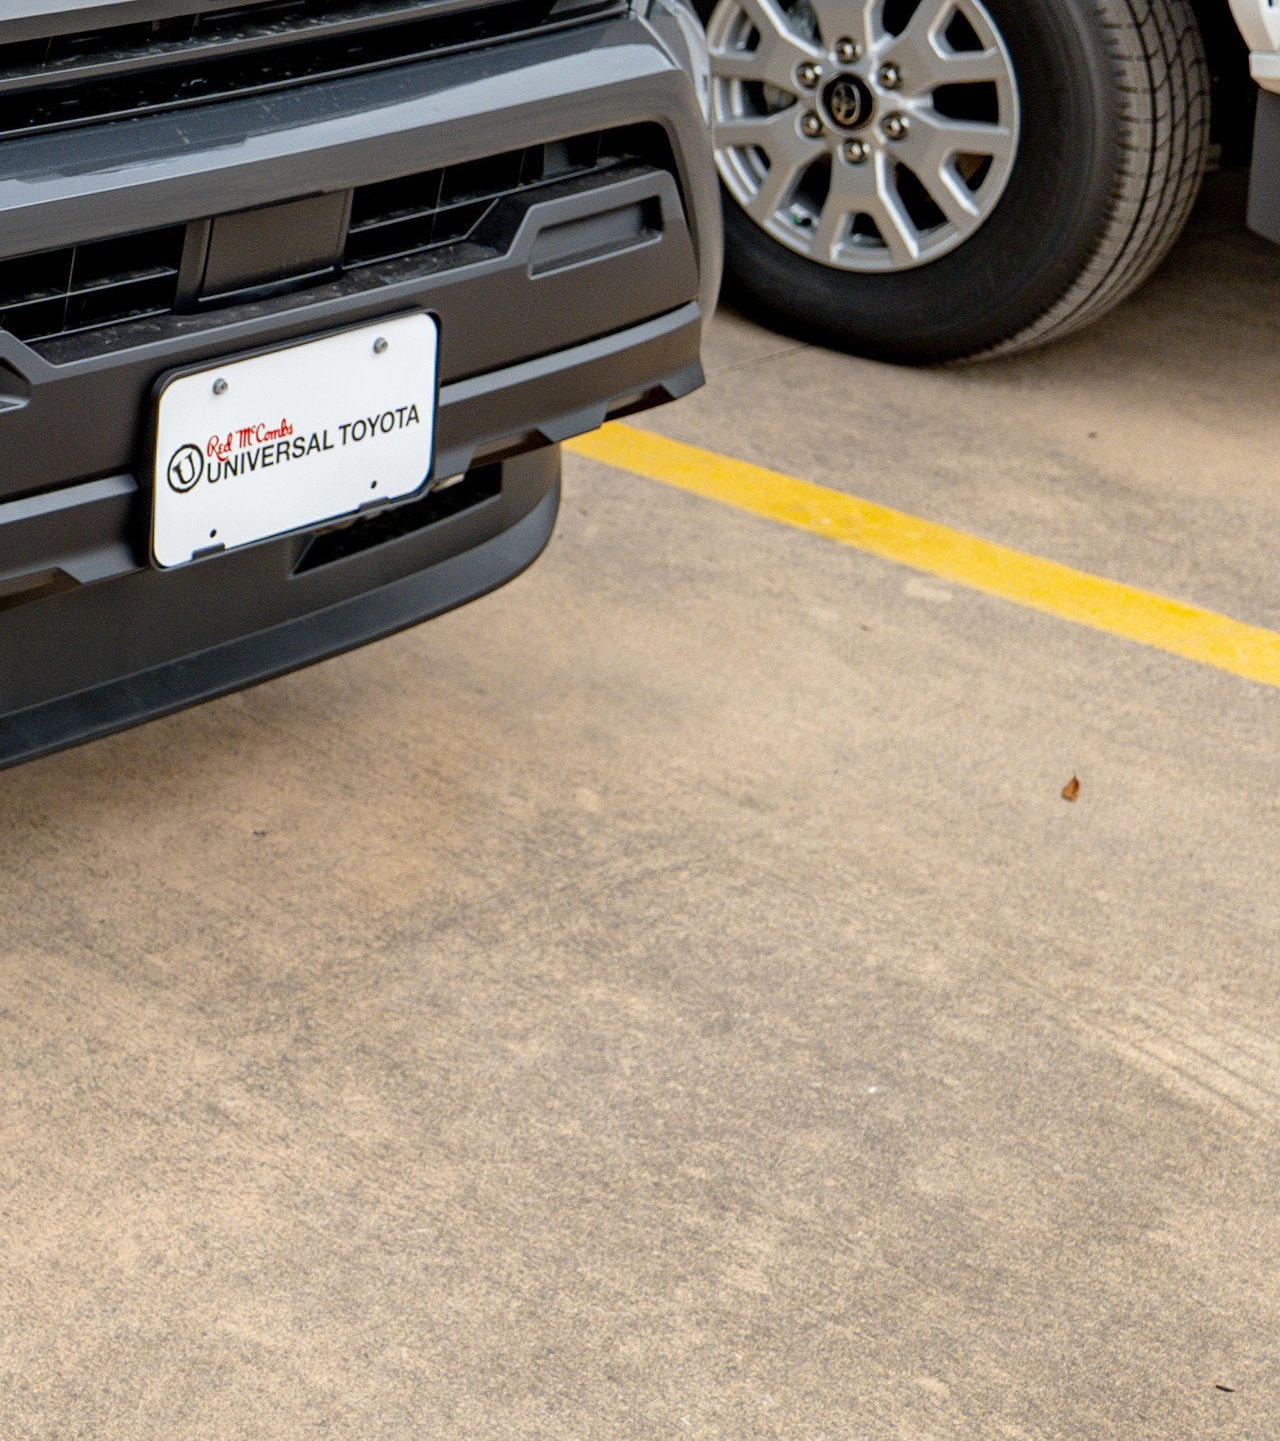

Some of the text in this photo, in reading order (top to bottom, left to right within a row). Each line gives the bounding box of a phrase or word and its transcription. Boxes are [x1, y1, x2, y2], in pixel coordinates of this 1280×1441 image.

[206, 419, 294, 462] Red McCombs
[206, 404, 420, 484] UNIVERSAL TOYOTA
